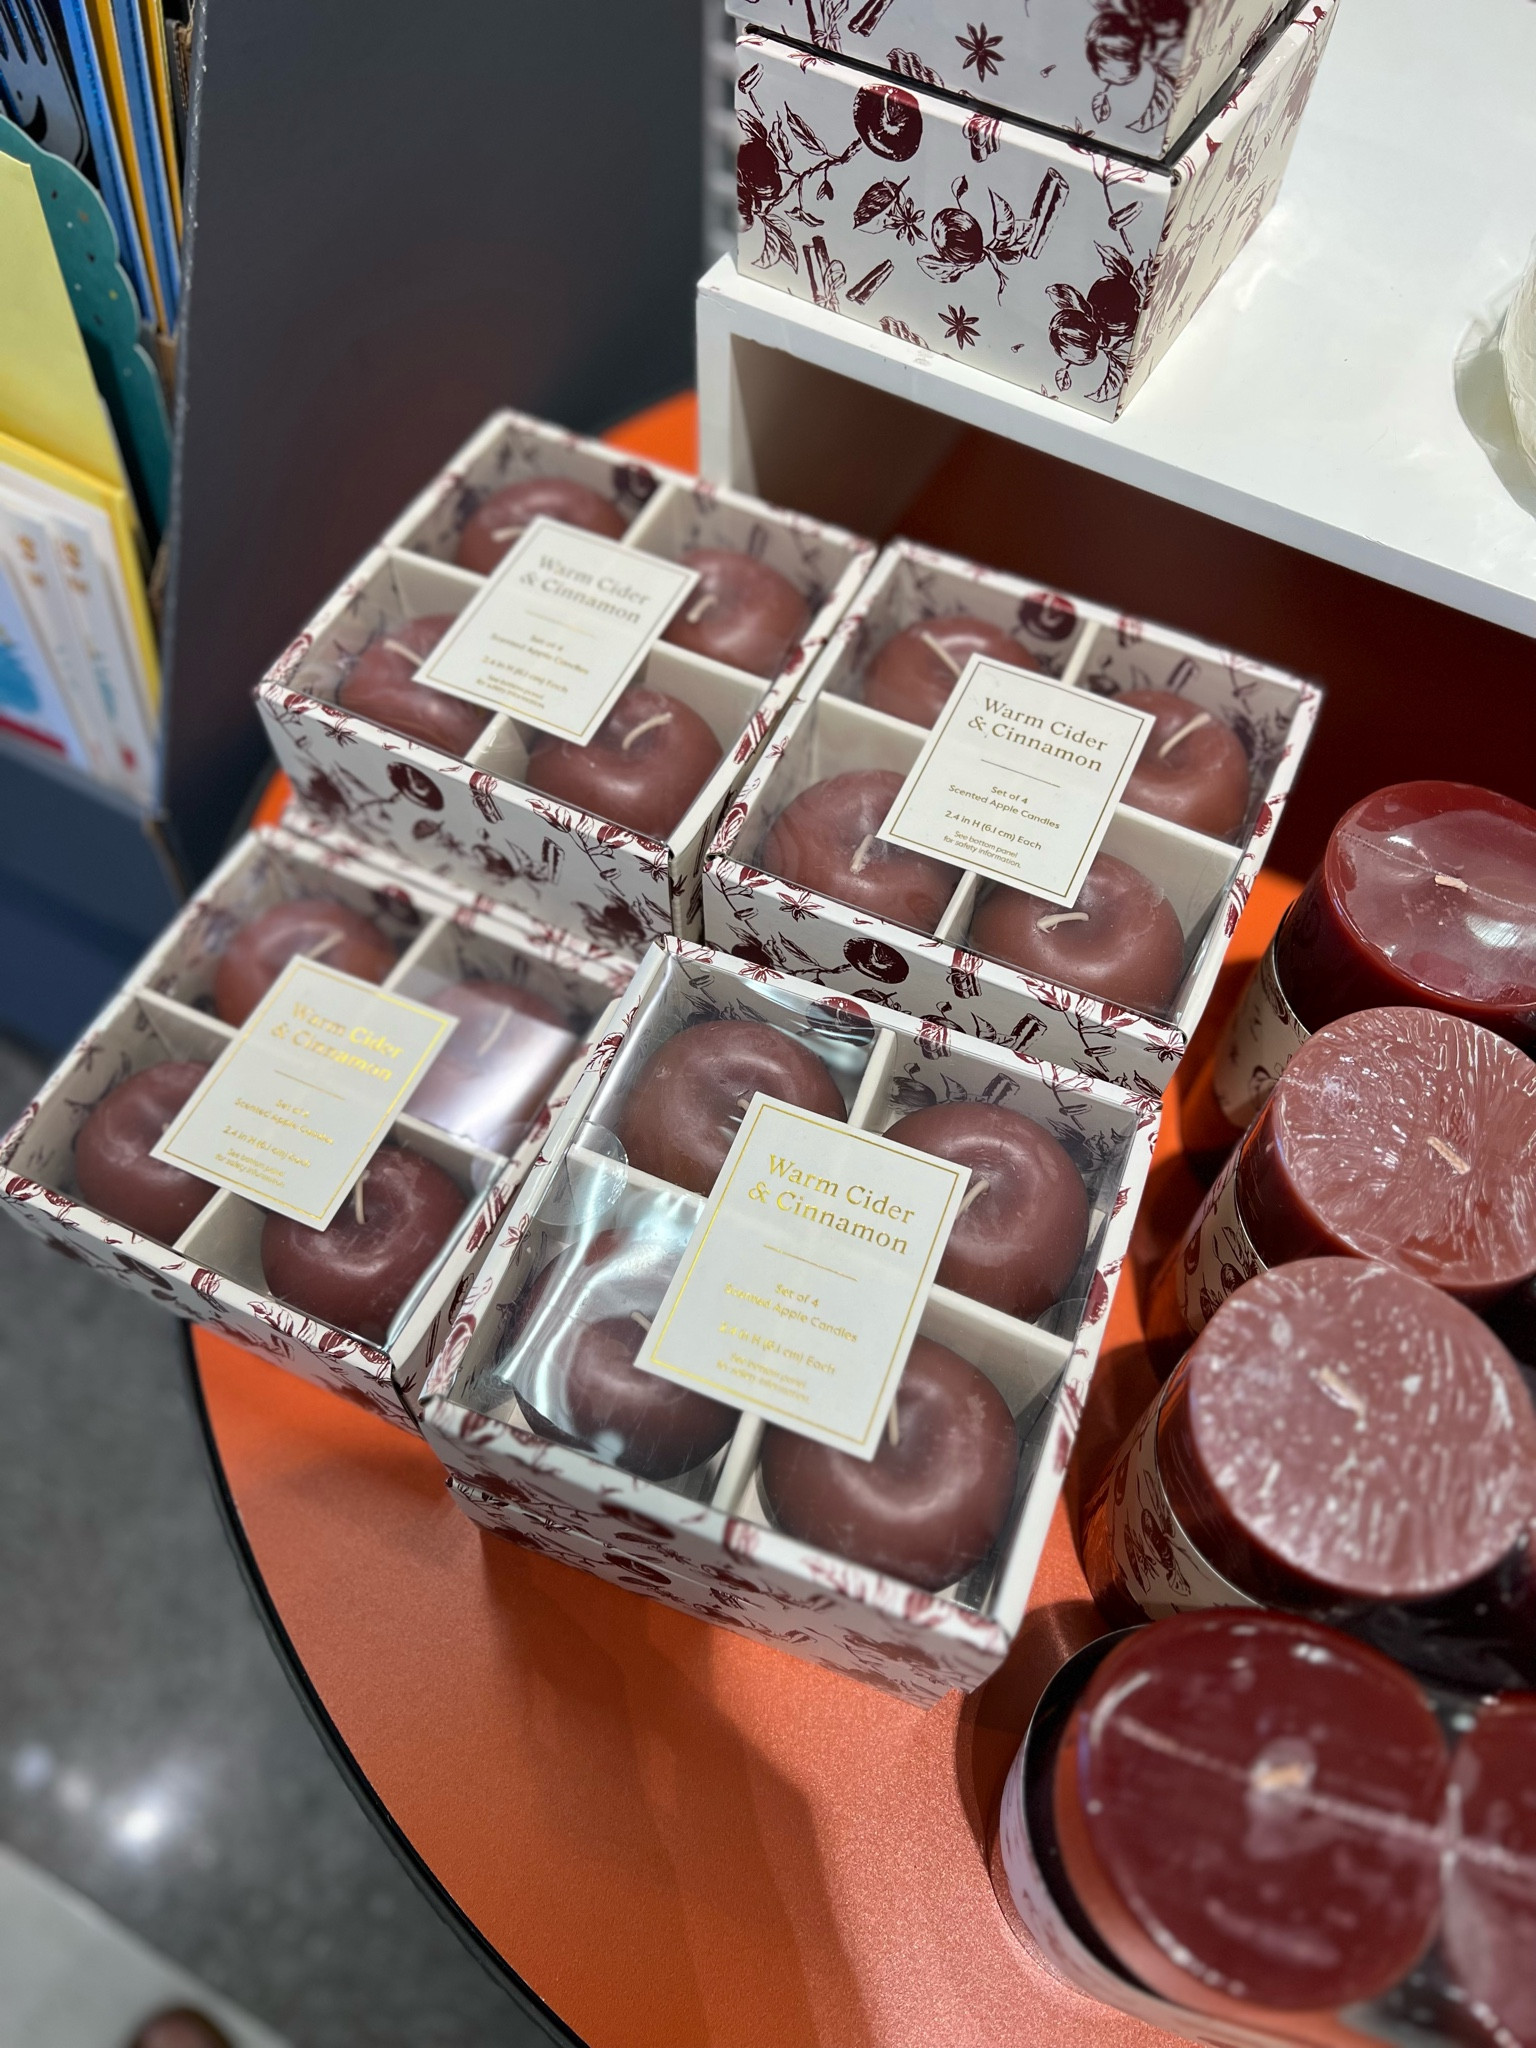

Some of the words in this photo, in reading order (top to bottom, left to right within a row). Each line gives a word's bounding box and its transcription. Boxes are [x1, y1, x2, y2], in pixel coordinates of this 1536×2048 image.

[539, 554, 594, 586] Warm
[596, 576, 651, 605] Cider
[540, 578, 641, 624] Cinnamon
[968, 715, 987, 732] &
[992, 723, 1102, 772] Cinnamon
[985, 697, 1044, 729] Warm
[1050, 721, 1108, 752] Cider
[948, 784, 989, 804] Scented
[989, 799, 1019, 815] Apple
[1020, 809, 1060, 830] Candles
[991, 786, 1007, 798] Set
[1009, 793, 1020, 802] of
[1021, 797, 1029, 805] 4
[943, 835, 955, 844] for
[954, 839, 978, 854] safety
[978, 848, 1021, 869] information.
[944, 810, 960, 820] 2.4
[961, 815, 971, 825] in
[971, 819, 981, 828] H
[997, 829, 1016, 842] cm)
[1017, 835, 1042, 850] Each
[954, 830, 968, 840] See
[969, 835, 996, 850] bottom
[995, 846, 1018, 859] panel
[270, 1021, 289, 1039] &
[291, 1029, 393, 1083] Cinnamon
[292, 1001, 347, 1037] Warm
[349, 1026, 404, 1059] Cider
[769, 1153, 839, 1198] Warm
[846, 1184, 915, 1224] Cider
[748, 1181, 771, 1204] &
[776, 1190, 908, 1255] Cinnamon
[774, 1282, 794, 1299] Set
[796, 1293, 811, 1304] of
[811, 1298, 820, 1309] 4
[773, 1302, 808, 1323] Apple
[810, 1316, 859, 1344] Candles
[806, 1356, 837, 1375] Each
